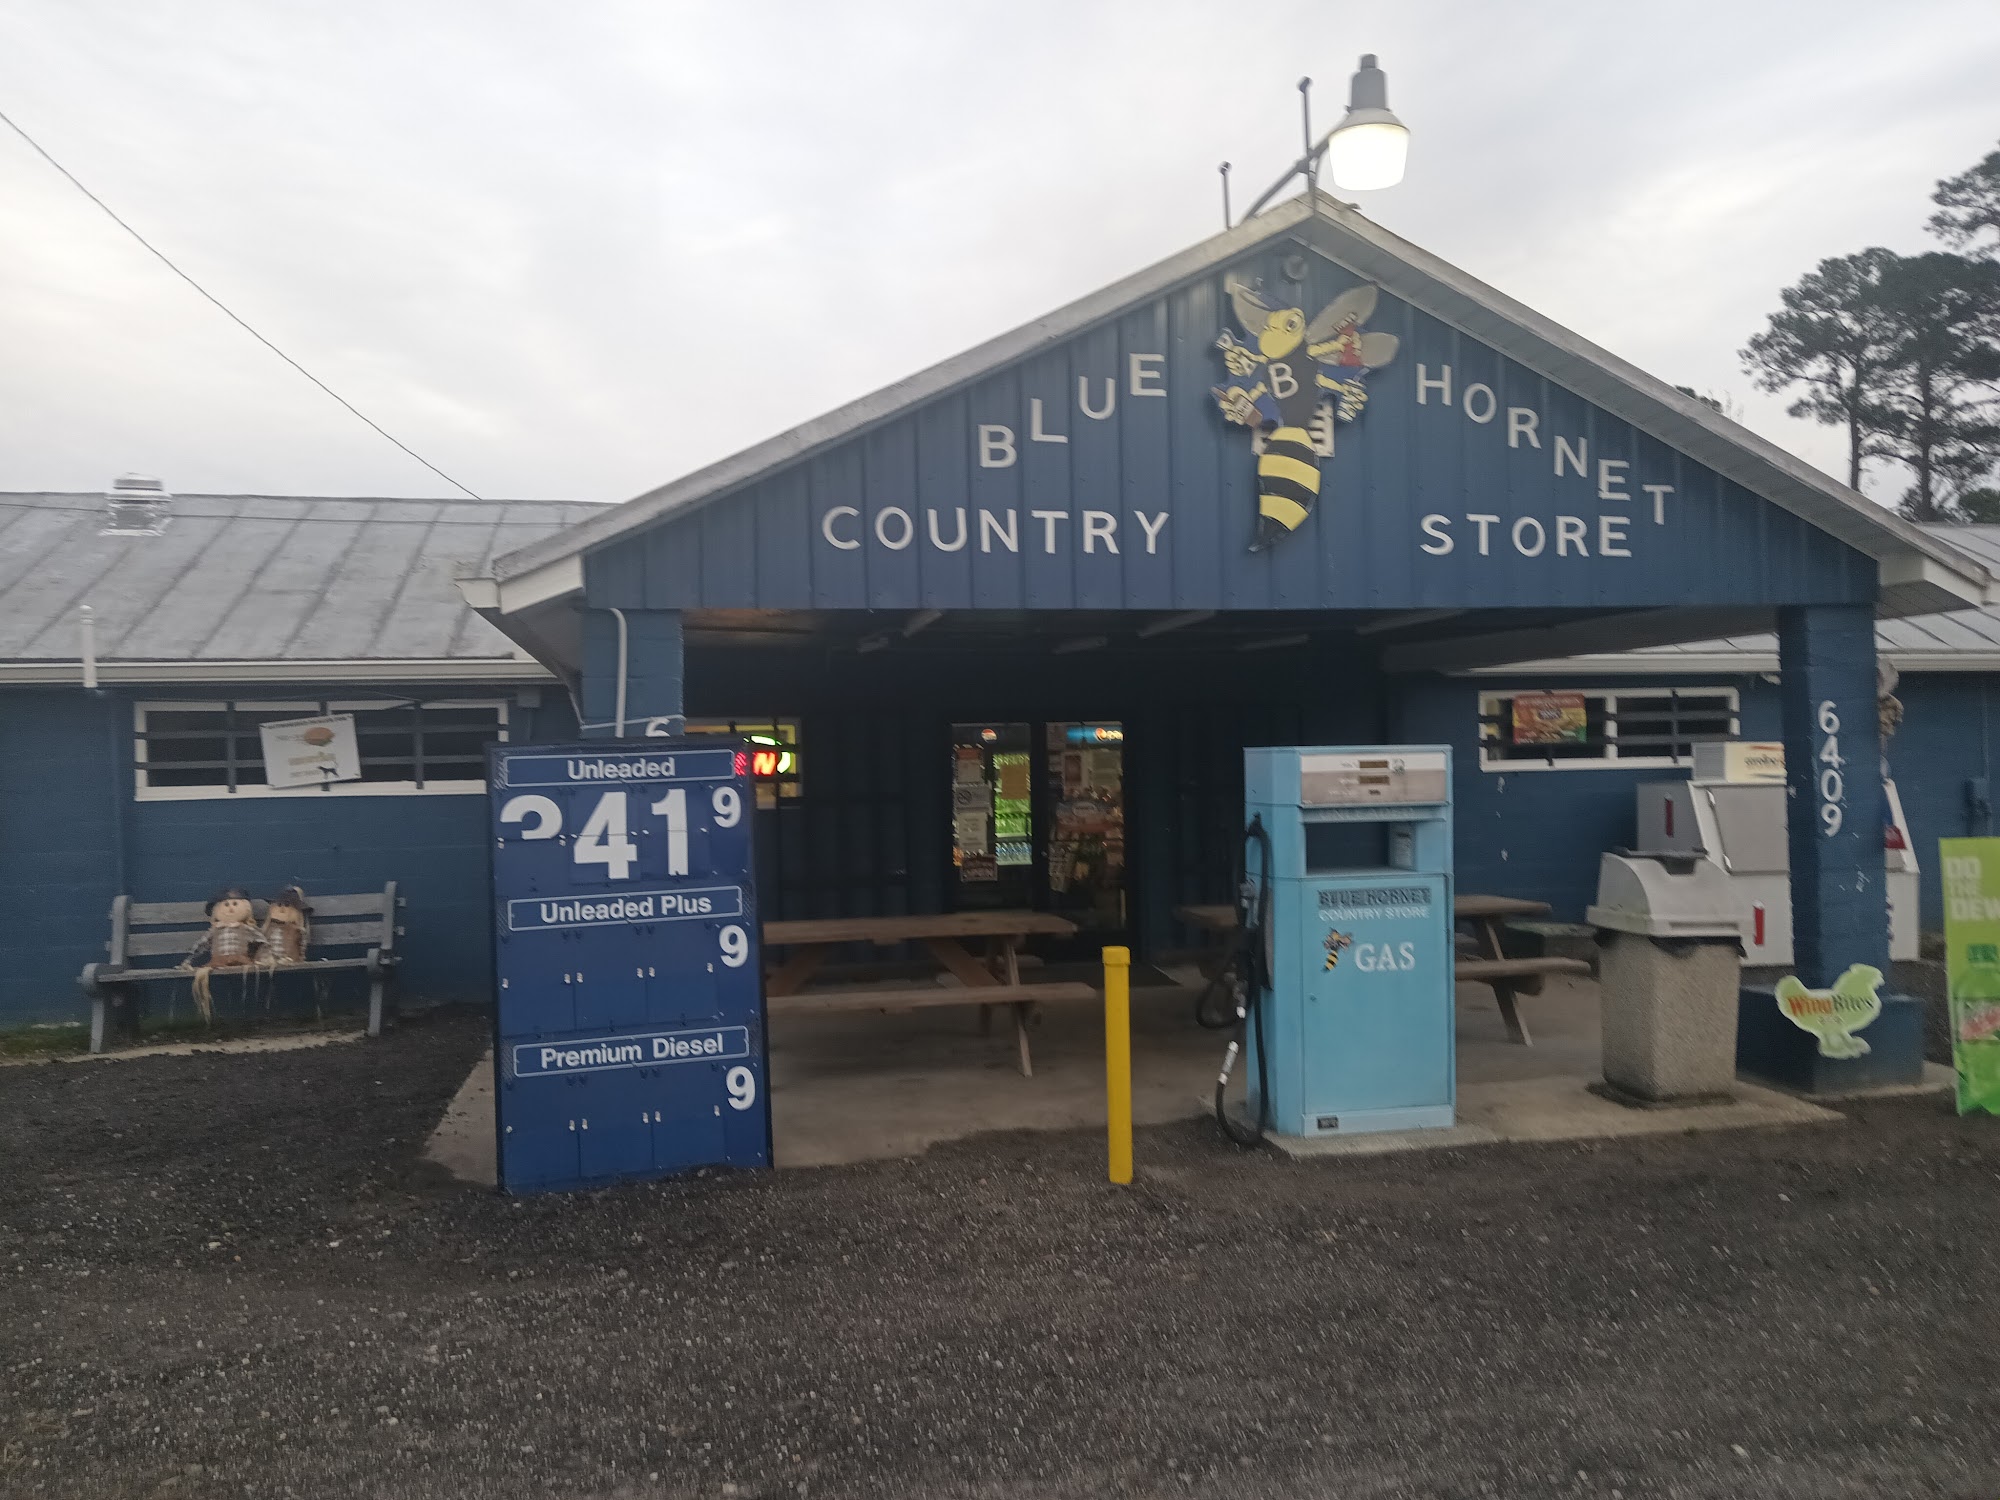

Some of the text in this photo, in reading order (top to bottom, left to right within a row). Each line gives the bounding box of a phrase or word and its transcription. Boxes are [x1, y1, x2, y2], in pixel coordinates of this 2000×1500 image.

[1268, 362, 1299, 400] B
[978, 353, 1675, 525] BLUE HORNET
[822, 506, 1632, 558] COUNTRY STORE
[567, 757, 675, 780] Unleaded
[1818, 700, 1846, 837] 6409
[712, 786, 741, 828] 9
[1944, 857, 1982, 879] DO
[540, 894, 712, 924] Unleaded Plus
[719, 924, 749, 968] 9
[1355, 942, 1416, 972] GAS
[540, 1033, 724, 1069] Premium Diesel
[726, 1065, 756, 1111] 9
